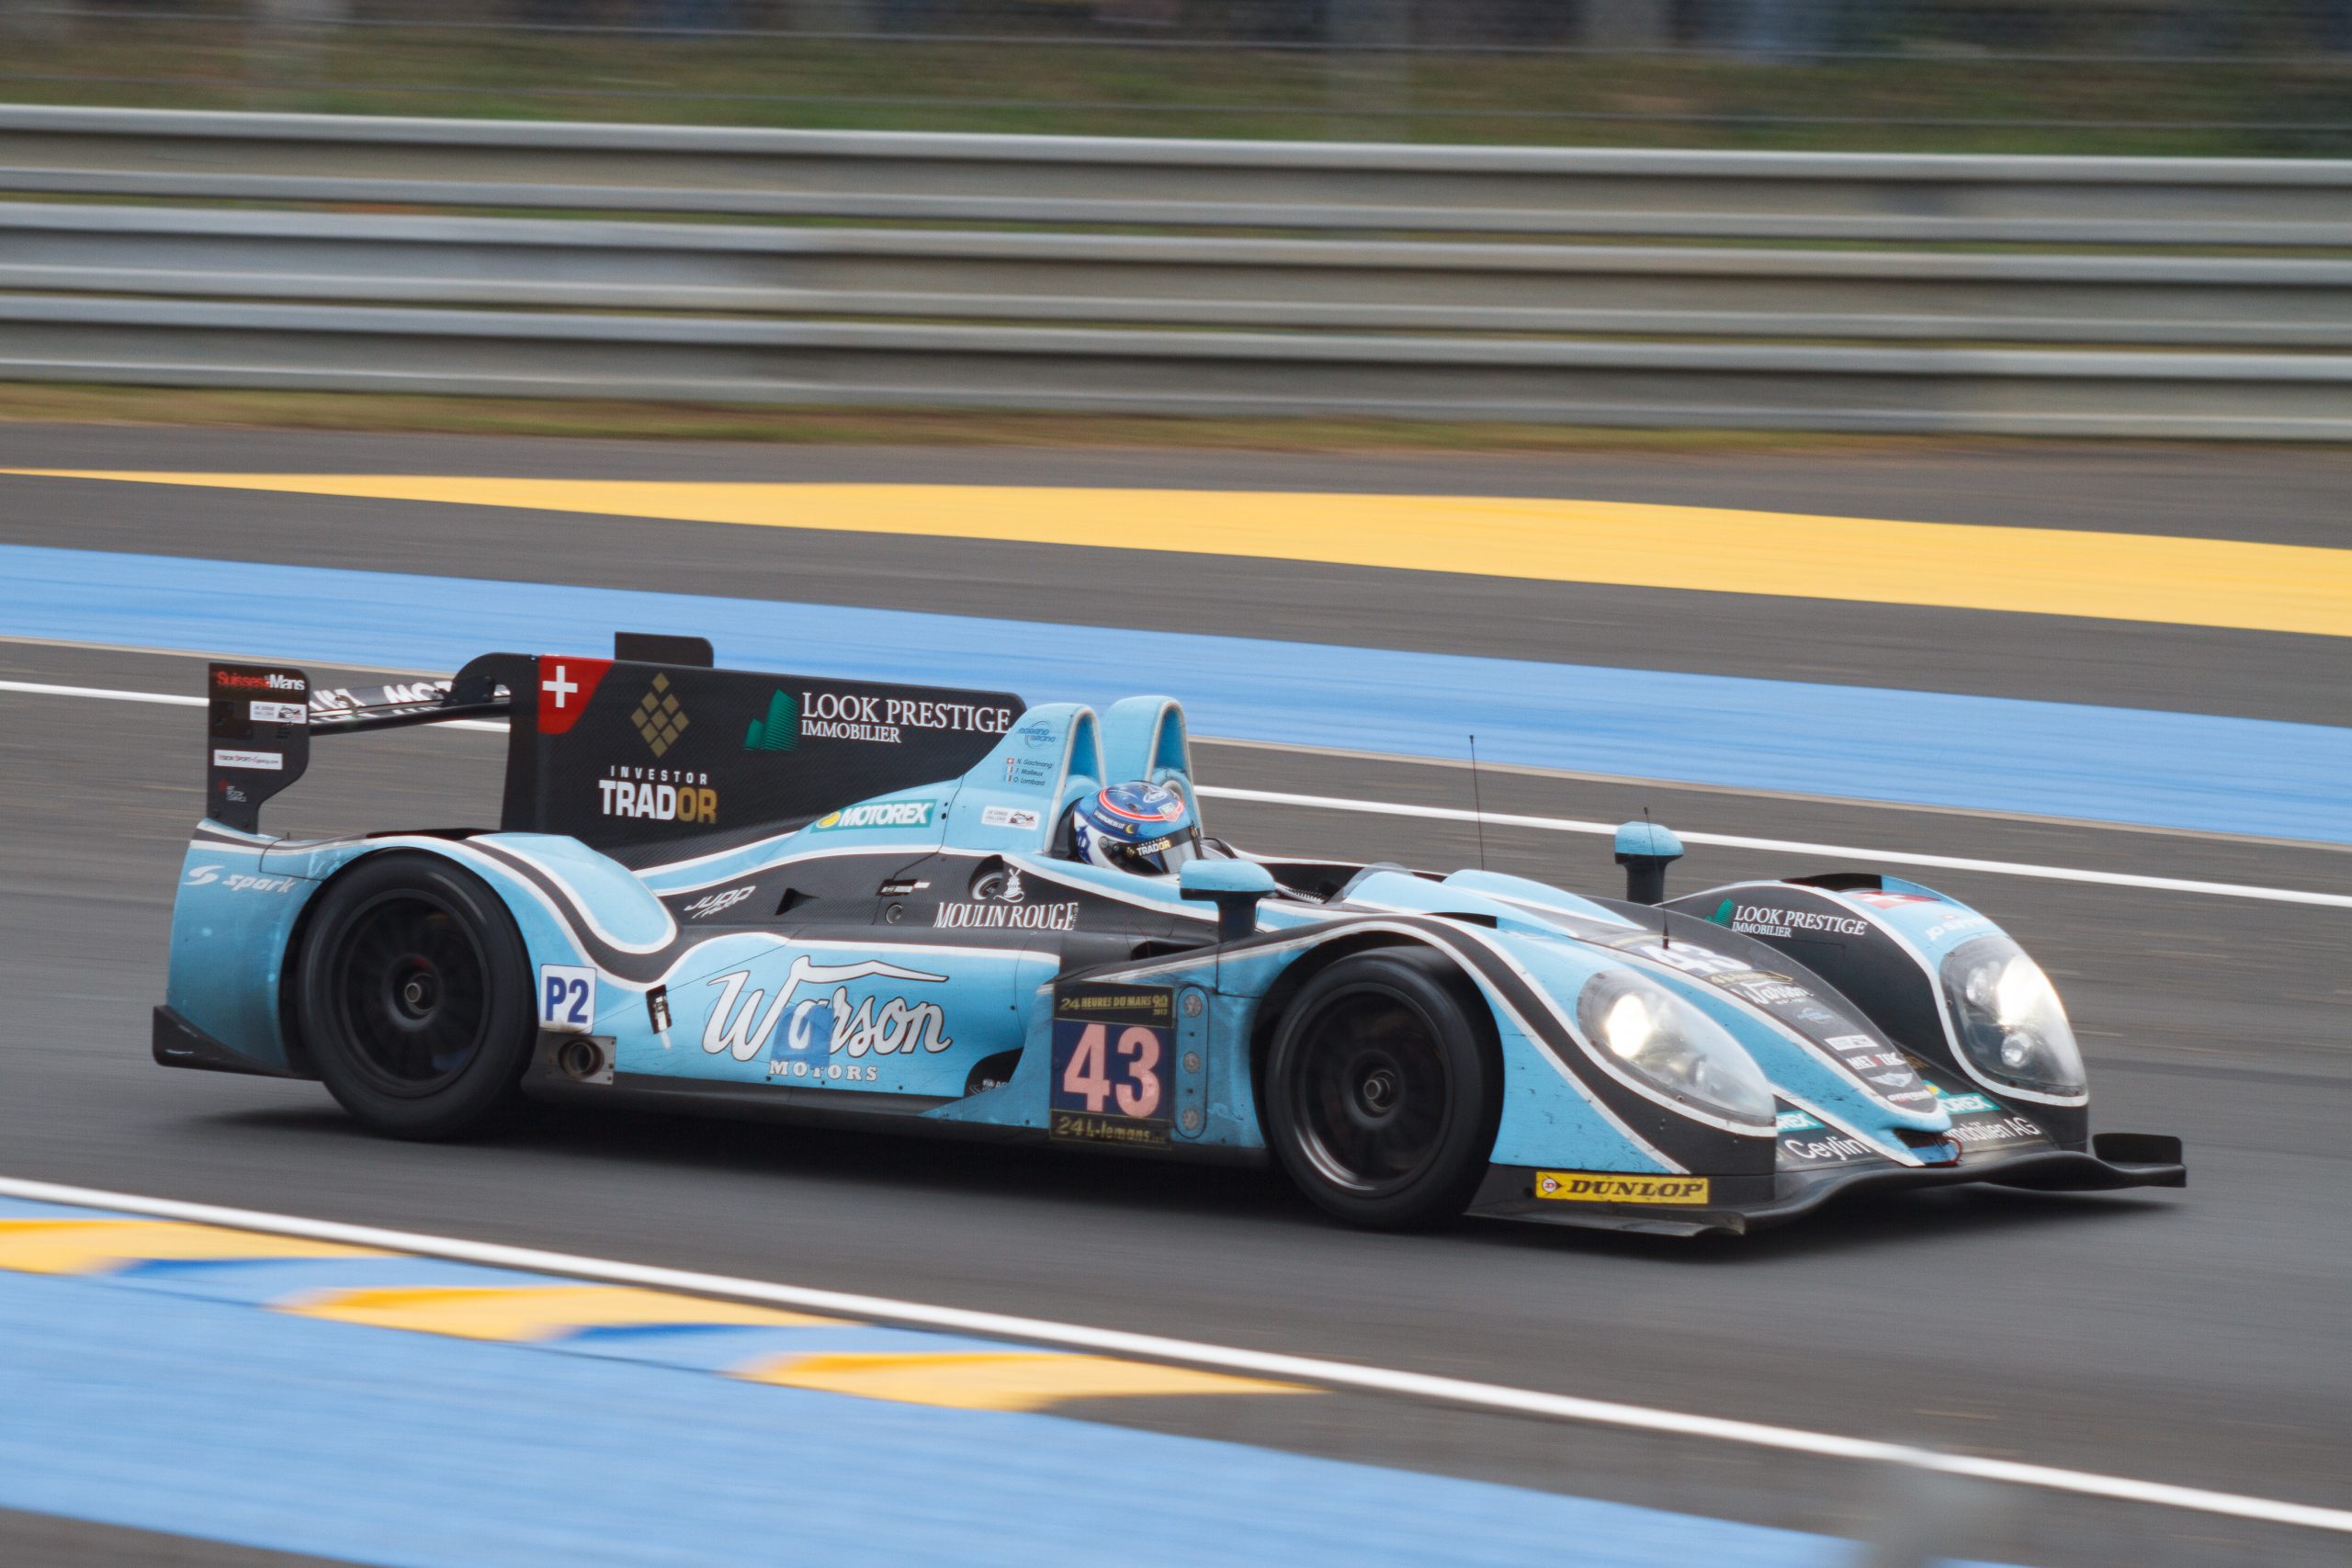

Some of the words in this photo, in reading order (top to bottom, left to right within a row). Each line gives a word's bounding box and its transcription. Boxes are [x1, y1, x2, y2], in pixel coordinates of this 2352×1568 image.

[269, 673, 306, 691] Mans
[801, 692, 880, 722] LOOK
[885, 698, 1012, 734] PRESTIGE
[800, 719, 902, 744] IMMOBILIER
[610, 765, 707, 784] INVESTOR
[598, 779, 718, 824] TRADOR
[838, 802, 933, 827] MOTOREX
[1136, 840, 1170, 855] TRADOR
[222, 874, 296, 893] spark
[683, 886, 756, 911] JUDD
[933, 901, 1013, 929] MOULIN
[1010, 901, 1079, 931] ROUGE
[1734, 905, 1783, 925] LOOK
[1783, 910, 1869, 936] PRESTIGE
[1732, 921, 1792, 938] IMMOBILIER
[545, 976, 590, 1024] P2
[1059, 998, 1080, 1011] 24
[1081, 996, 1113, 1008] HEURES
[1114, 997, 1126, 1008] DU
[1126, 995, 1152, 1007] MANS
[768, 1059, 878, 1081] MOTORS
[1063, 1022, 1161, 1118] 43
[2003, 1116, 2041, 1137] AG
[1784, 1135, 1871, 1161] Ceylin
[1567, 1179, 1703, 1197] DUNLOP
